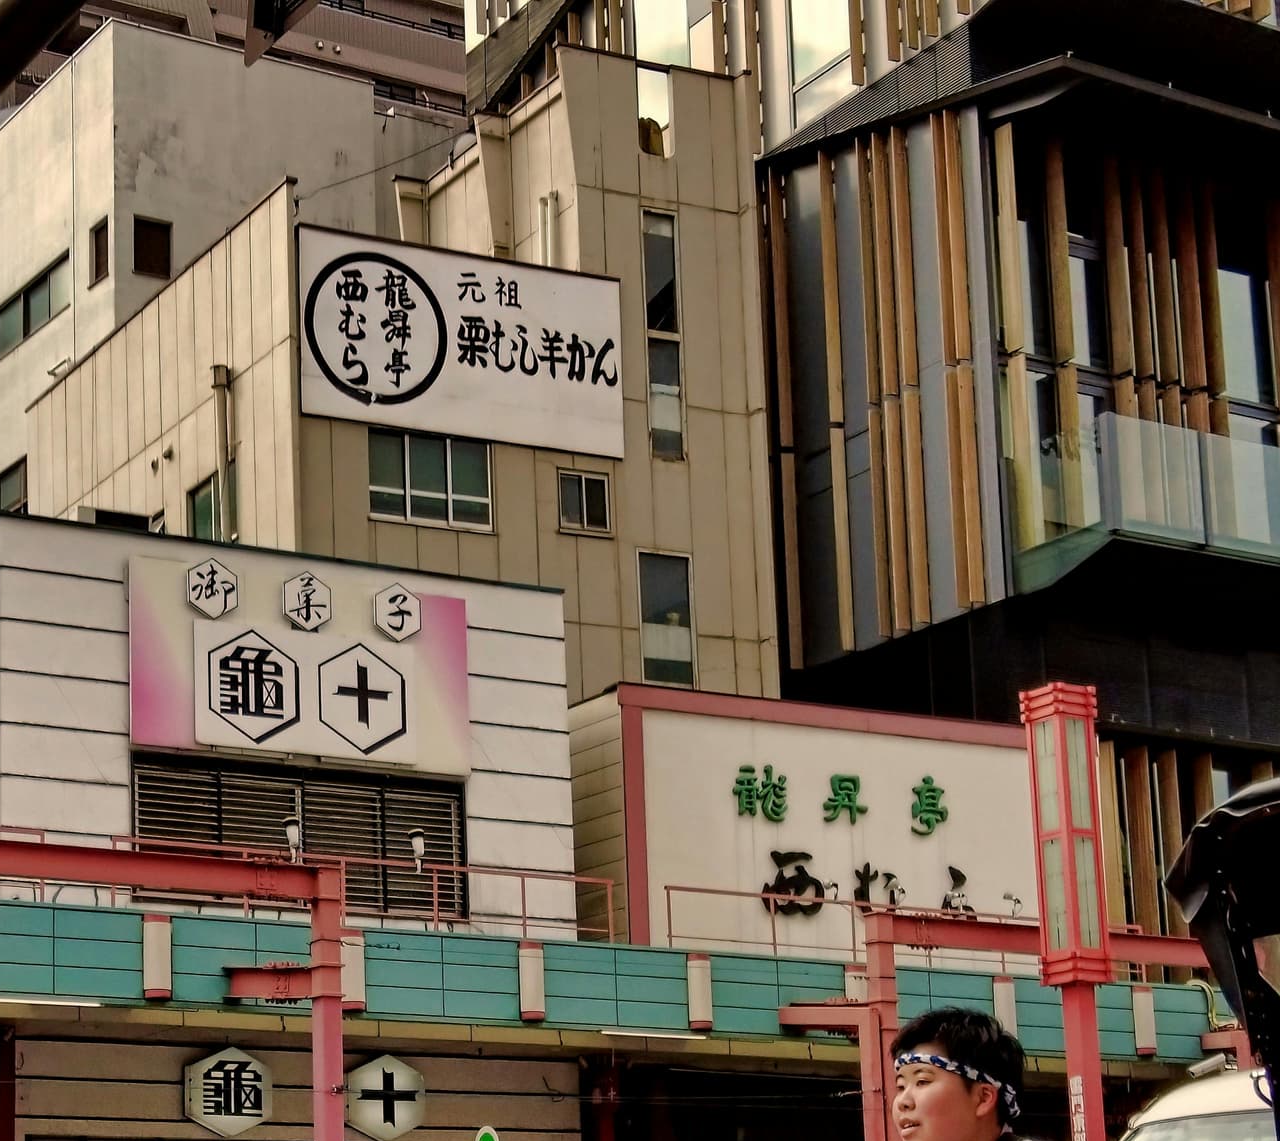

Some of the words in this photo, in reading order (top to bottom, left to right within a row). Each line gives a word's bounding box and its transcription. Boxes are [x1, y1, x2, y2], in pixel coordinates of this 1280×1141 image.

[457, 272, 522, 310] 元祖
[335, 269, 370, 386] 西むら
[456, 315, 618, 387] 栗むし羊かん
[732, 764, 949, 836] 龍昇亭
